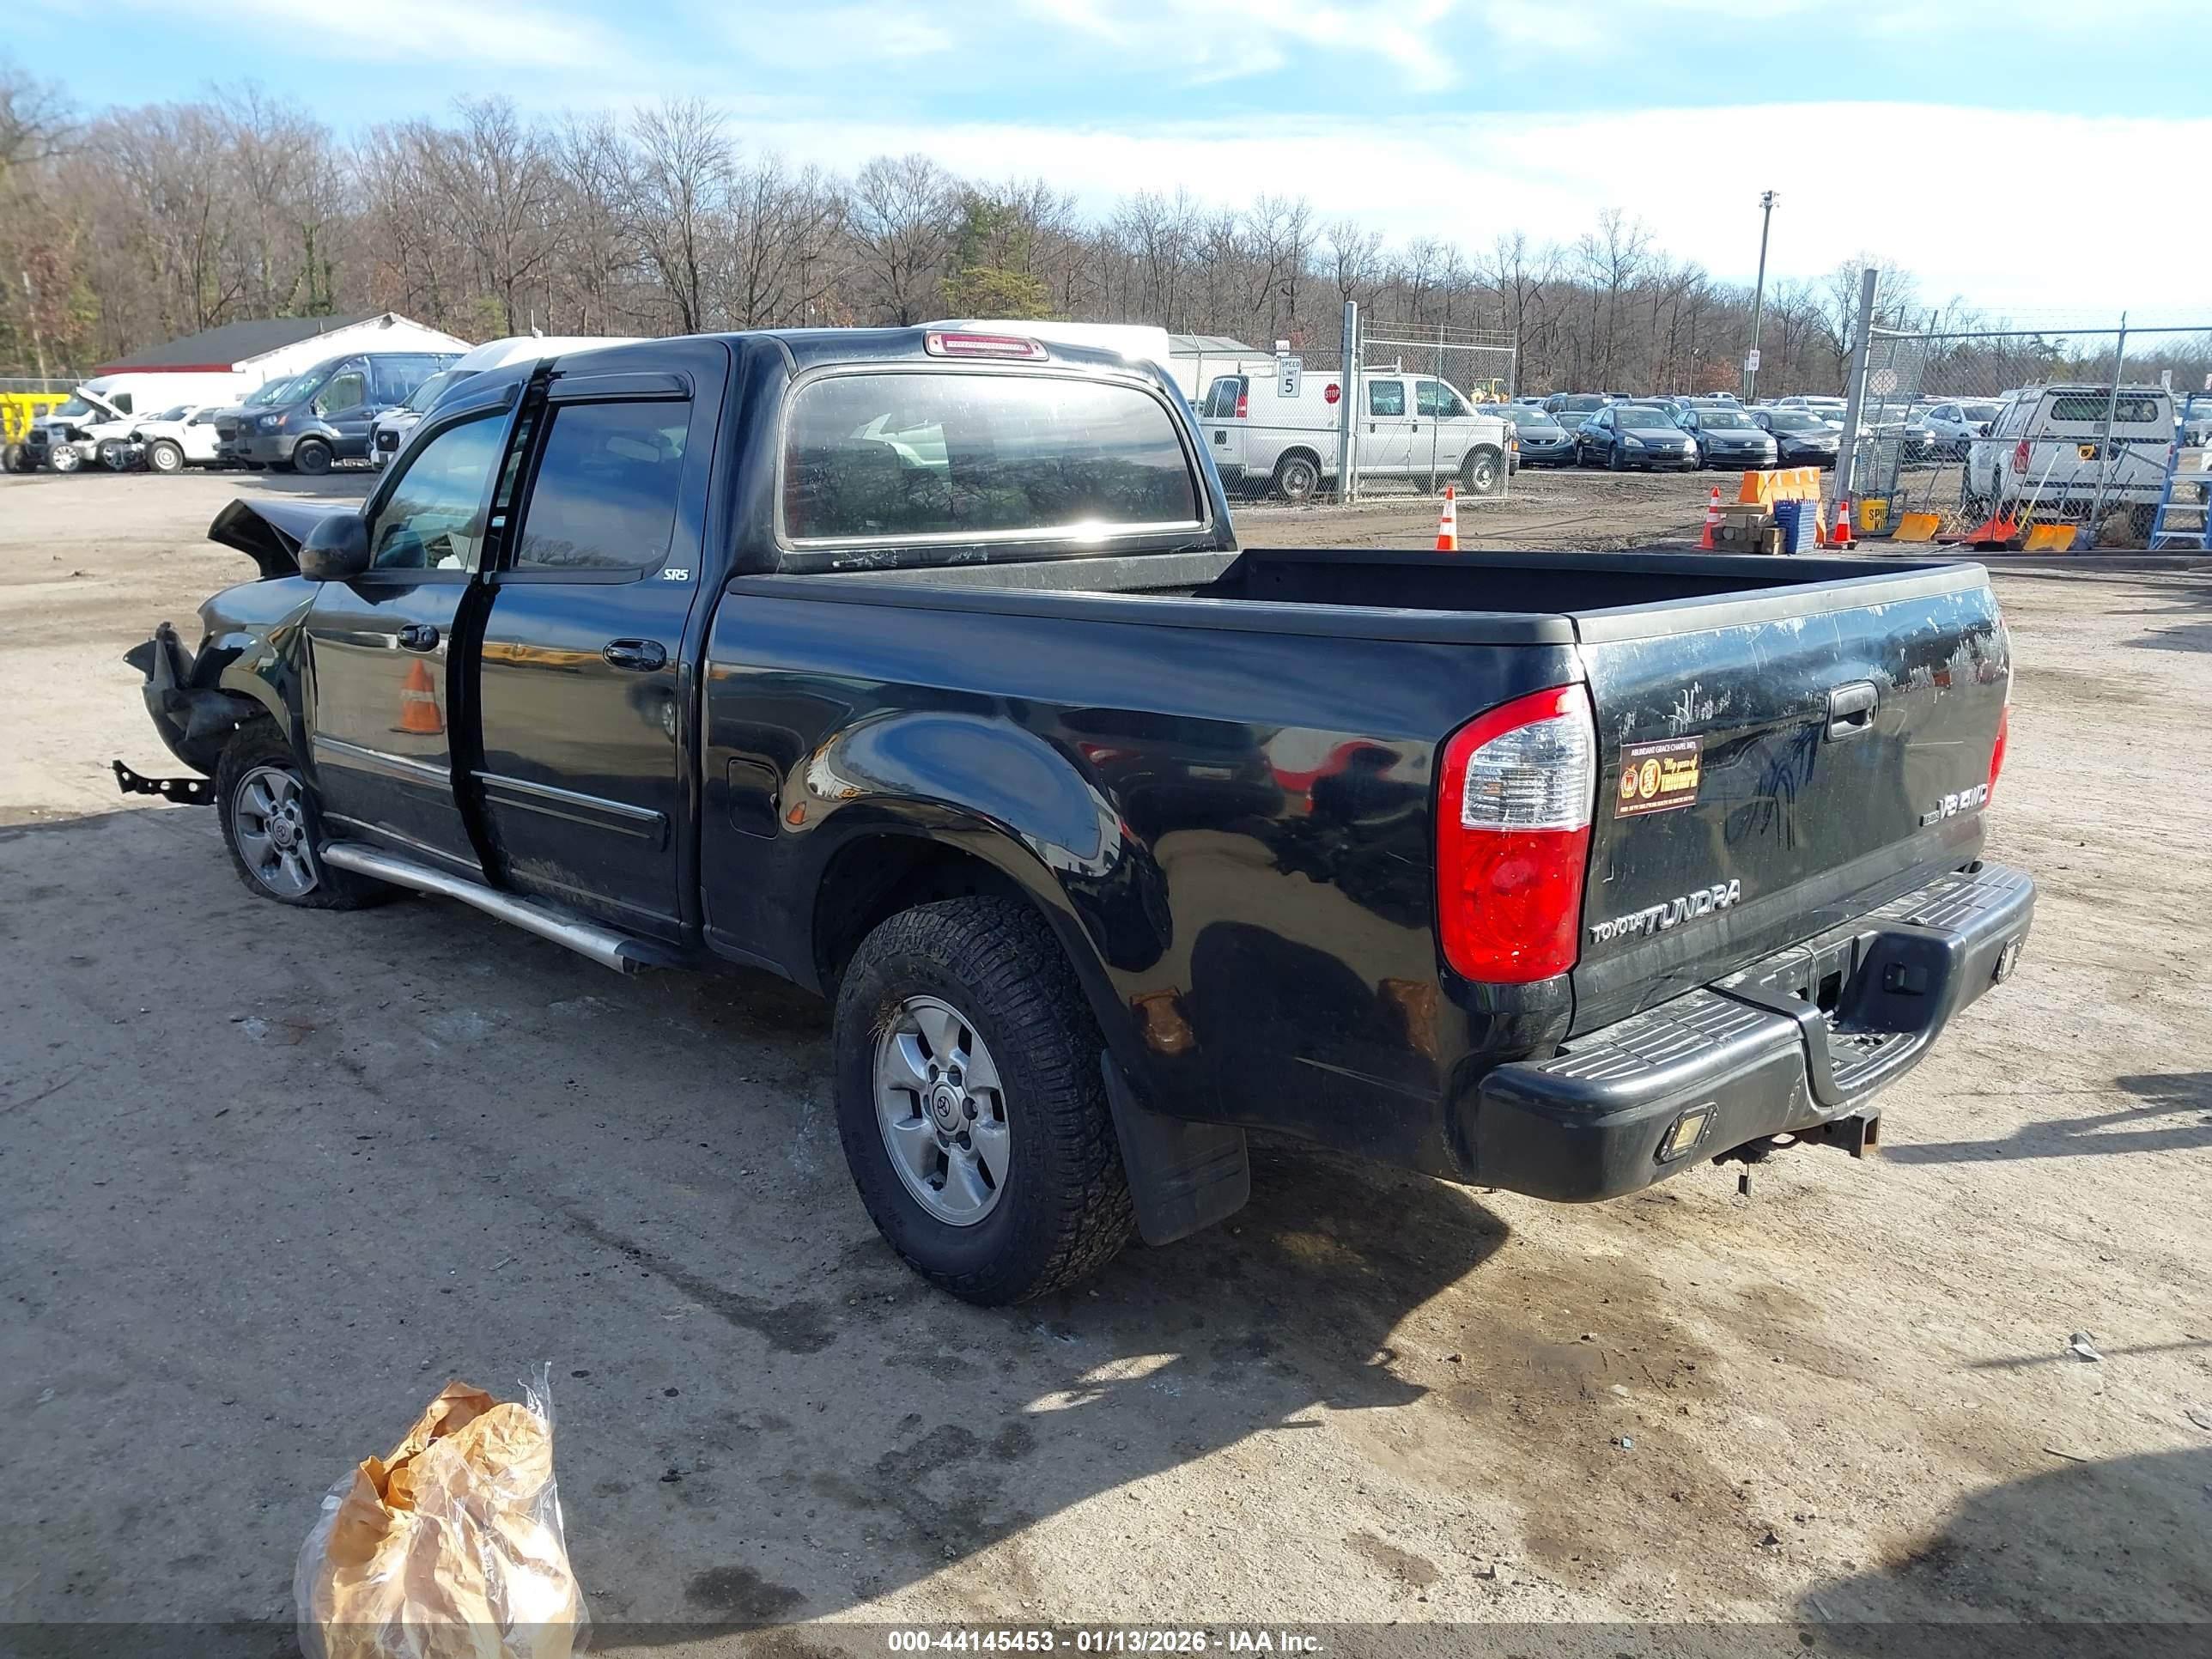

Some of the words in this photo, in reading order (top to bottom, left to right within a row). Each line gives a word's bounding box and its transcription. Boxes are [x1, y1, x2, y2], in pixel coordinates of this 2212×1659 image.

[1285, 379, 1293, 392] 5
[1325, 389, 1340, 398] STOP
[663, 568, 690, 581] SR5
[1631, 746, 1656, 757] ABUNDANT
[1656, 744, 1671, 753] GRACE
[1663, 757, 1676, 773] My
[1676, 759, 1689, 772] year
[1690, 753, 1698, 770] of
[1660, 769, 1699, 793] TRIUMPH
[1937, 794, 1958, 819] V8
[1958, 783, 1989, 811] 4WD
[1589, 913, 1645, 945] TOYOTA
[1641, 878, 1741, 937] TUNDRA
